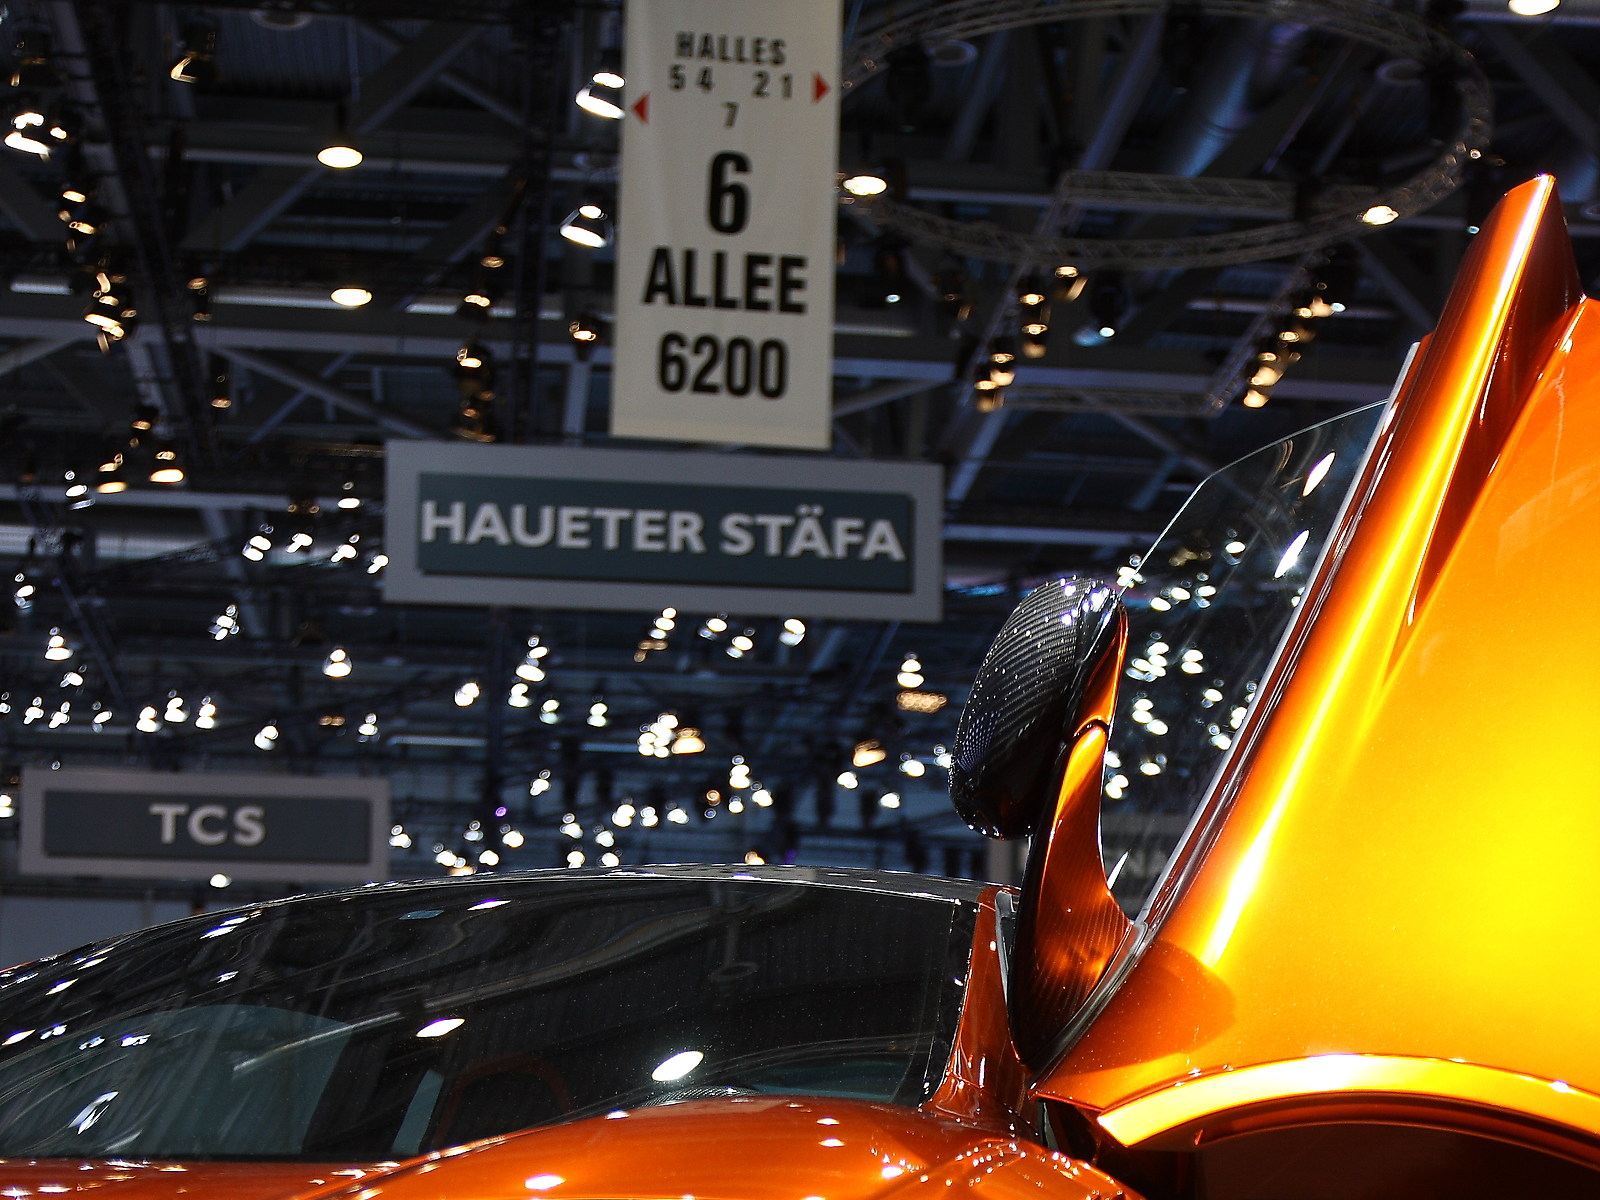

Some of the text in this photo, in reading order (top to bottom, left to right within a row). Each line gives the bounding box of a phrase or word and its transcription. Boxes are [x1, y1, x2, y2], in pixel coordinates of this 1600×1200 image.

[676, 31, 787, 66] HALLES
[723, 102, 739, 129] 7
[708, 151, 752, 236] 6
[643, 246, 808, 315] ALLEE
[658, 332, 788, 399] 6200
[421, 500, 906, 562] HAUETER STÄFA
[149, 803, 266, 847] TCS
